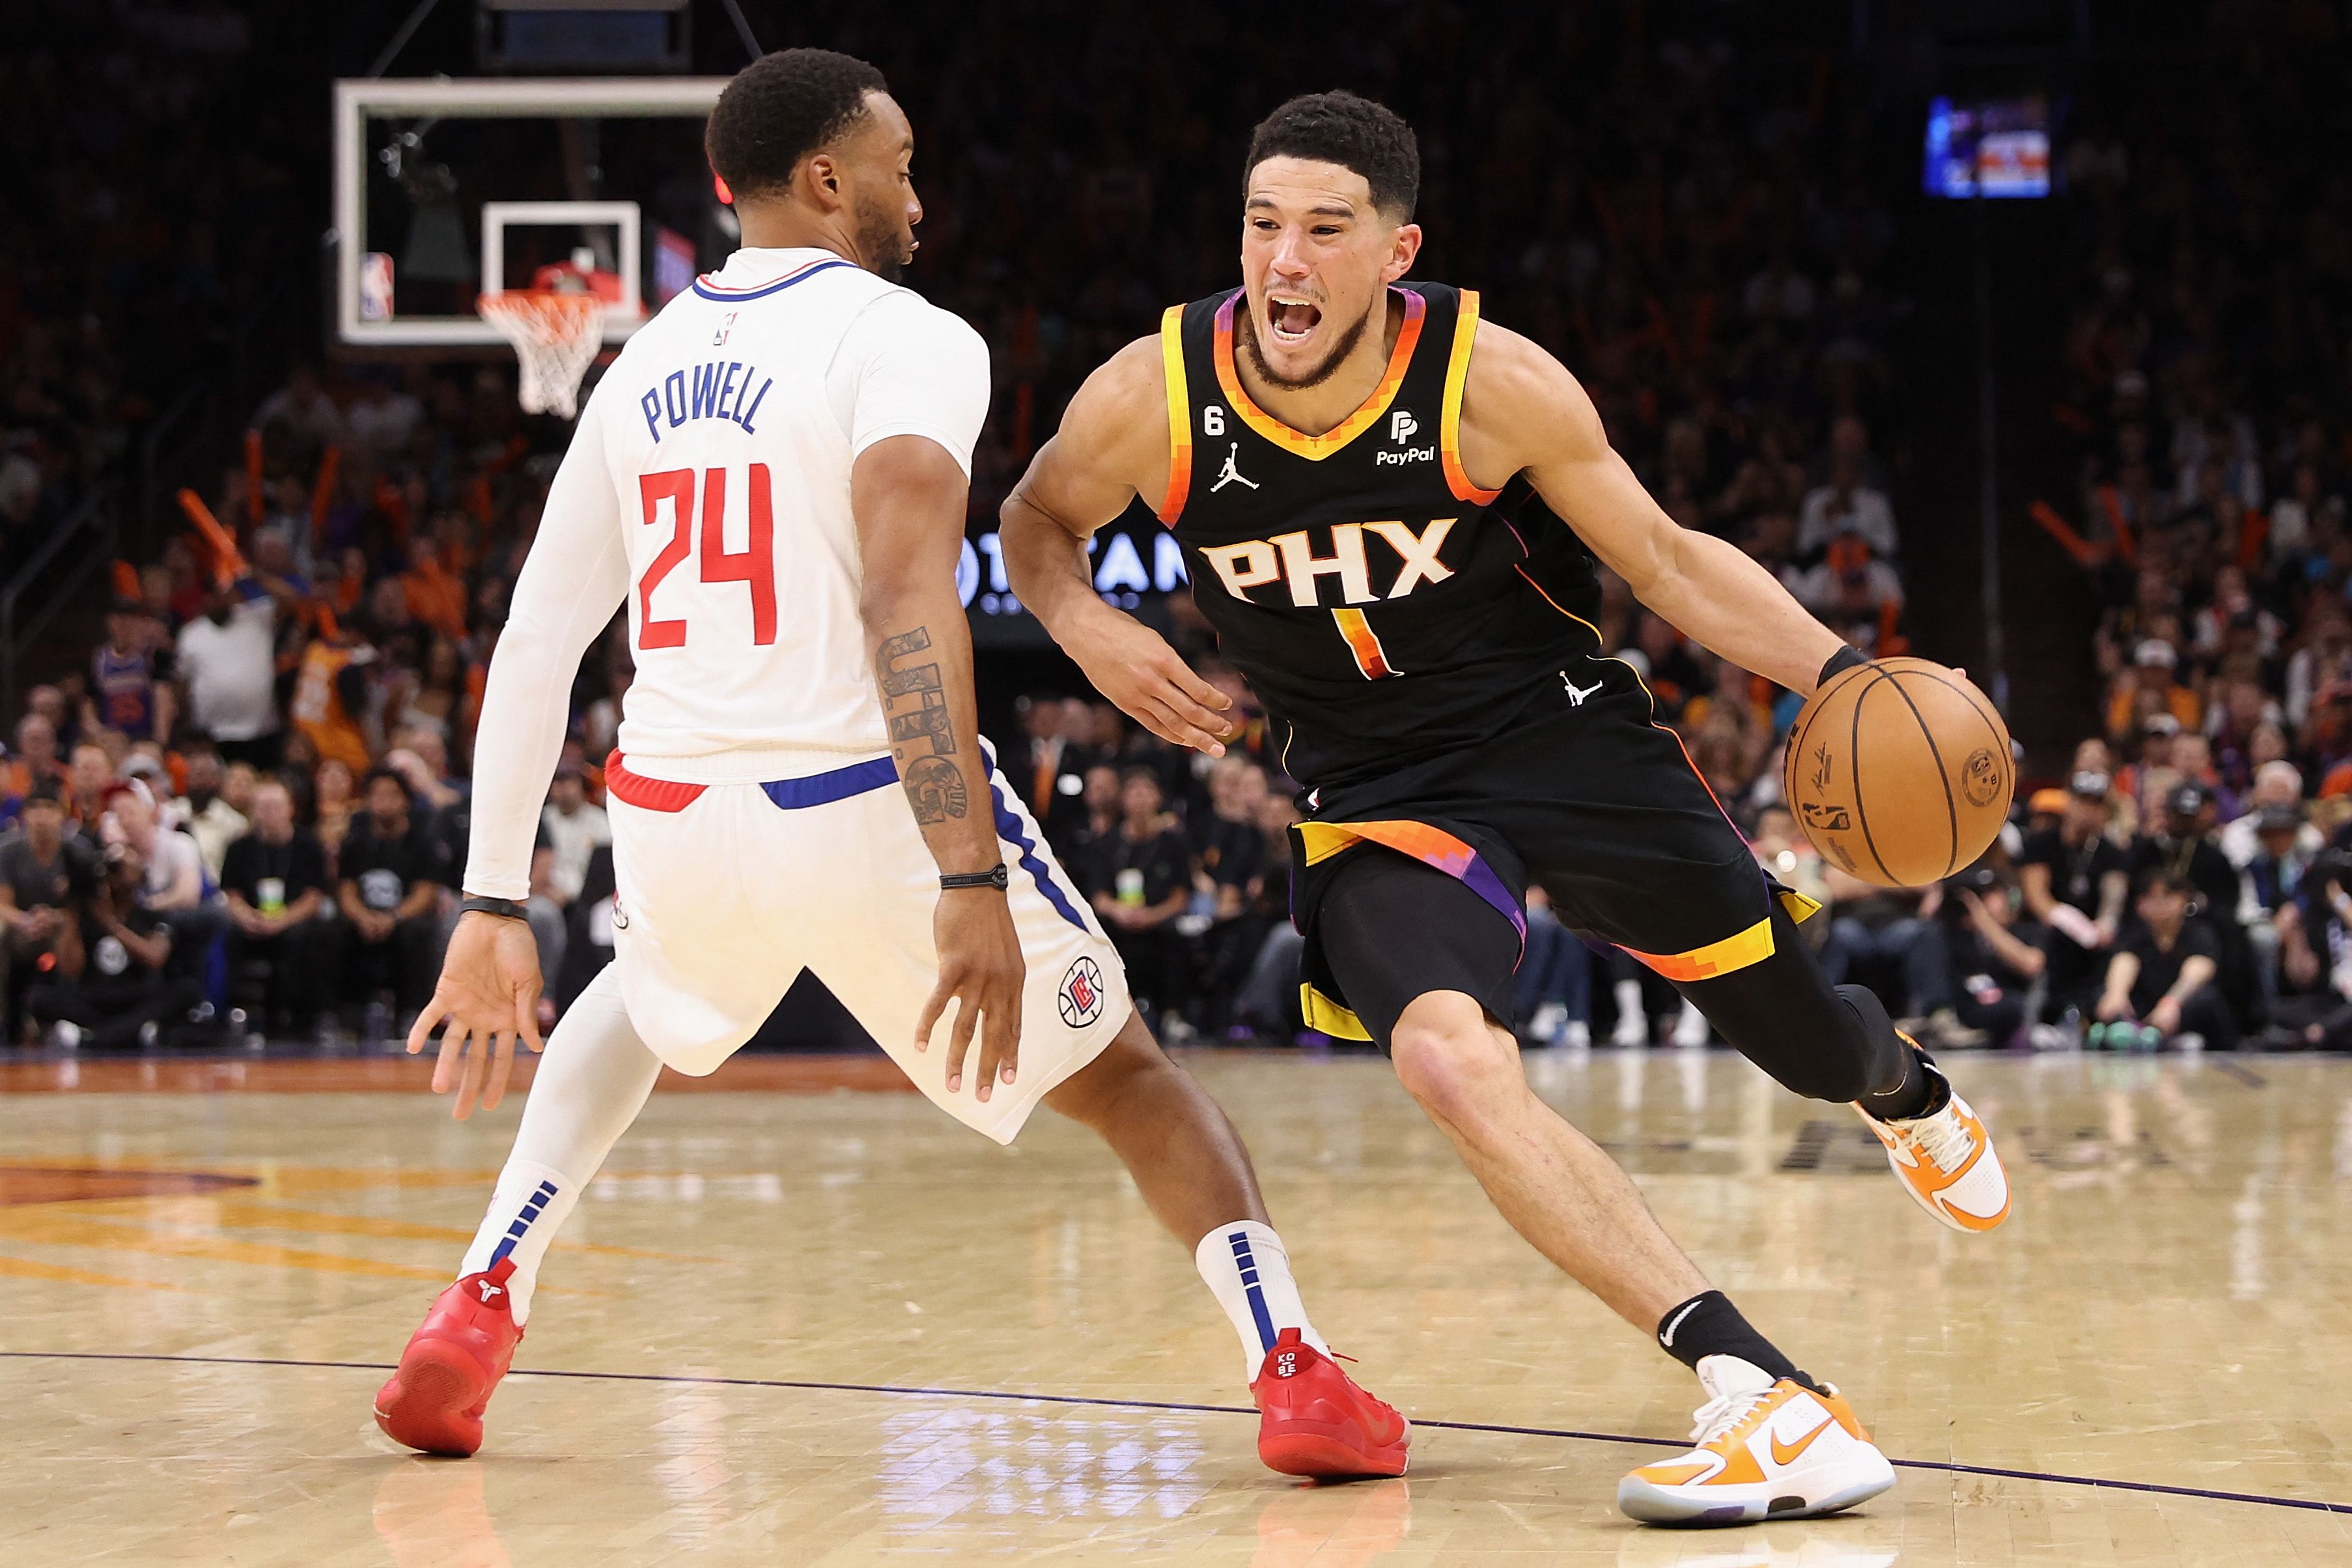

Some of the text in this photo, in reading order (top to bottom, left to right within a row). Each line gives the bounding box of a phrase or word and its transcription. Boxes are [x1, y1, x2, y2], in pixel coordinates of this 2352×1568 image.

[641, 361, 773, 443] POWELL
[1204, 406, 1224, 436] 6
[1376, 446, 1435, 466] PayPal
[638, 462, 777, 650] 24
[1197, 518, 1458, 608] PHX
[1330, 608, 1405, 681] 1
